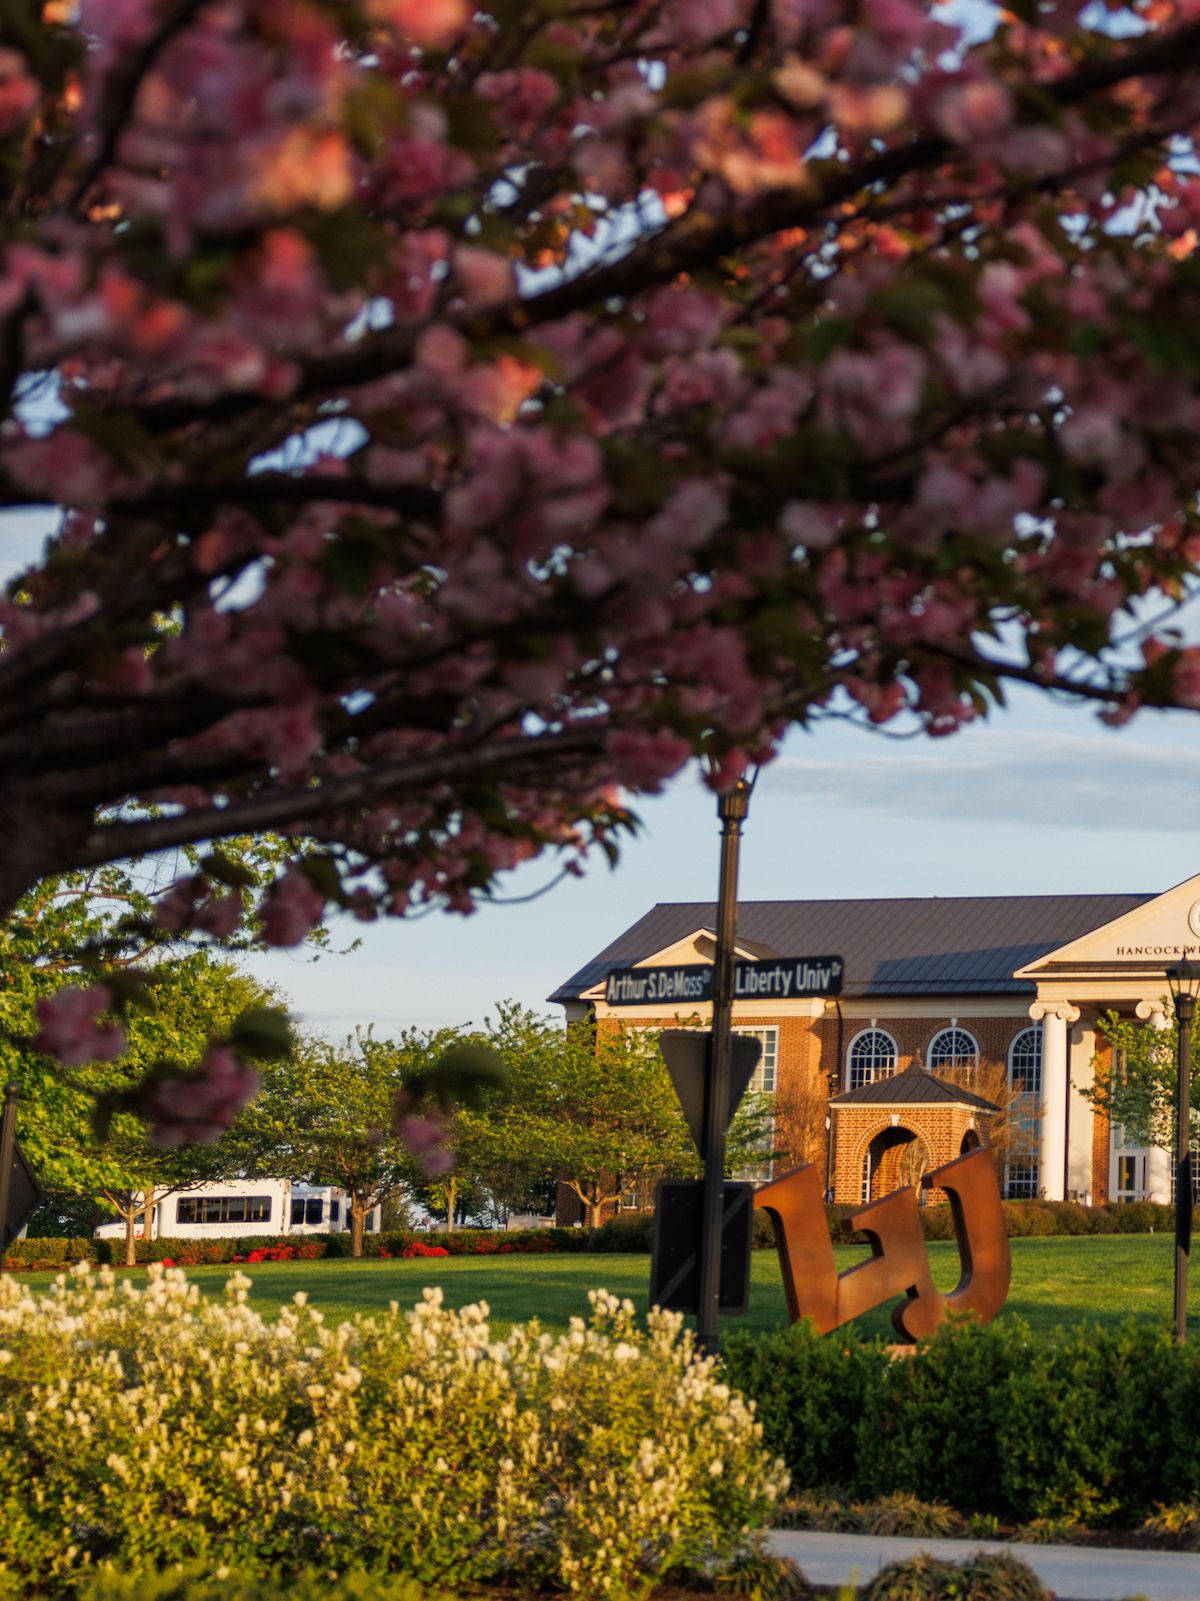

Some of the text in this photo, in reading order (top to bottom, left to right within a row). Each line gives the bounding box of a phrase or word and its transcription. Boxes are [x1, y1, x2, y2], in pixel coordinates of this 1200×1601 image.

[1117, 945, 1180, 955] HANCOCK
[607, 974, 648, 1000] Arthur
[735, 965, 793, 996] Liberty
[796, 962, 831, 990] Univ
